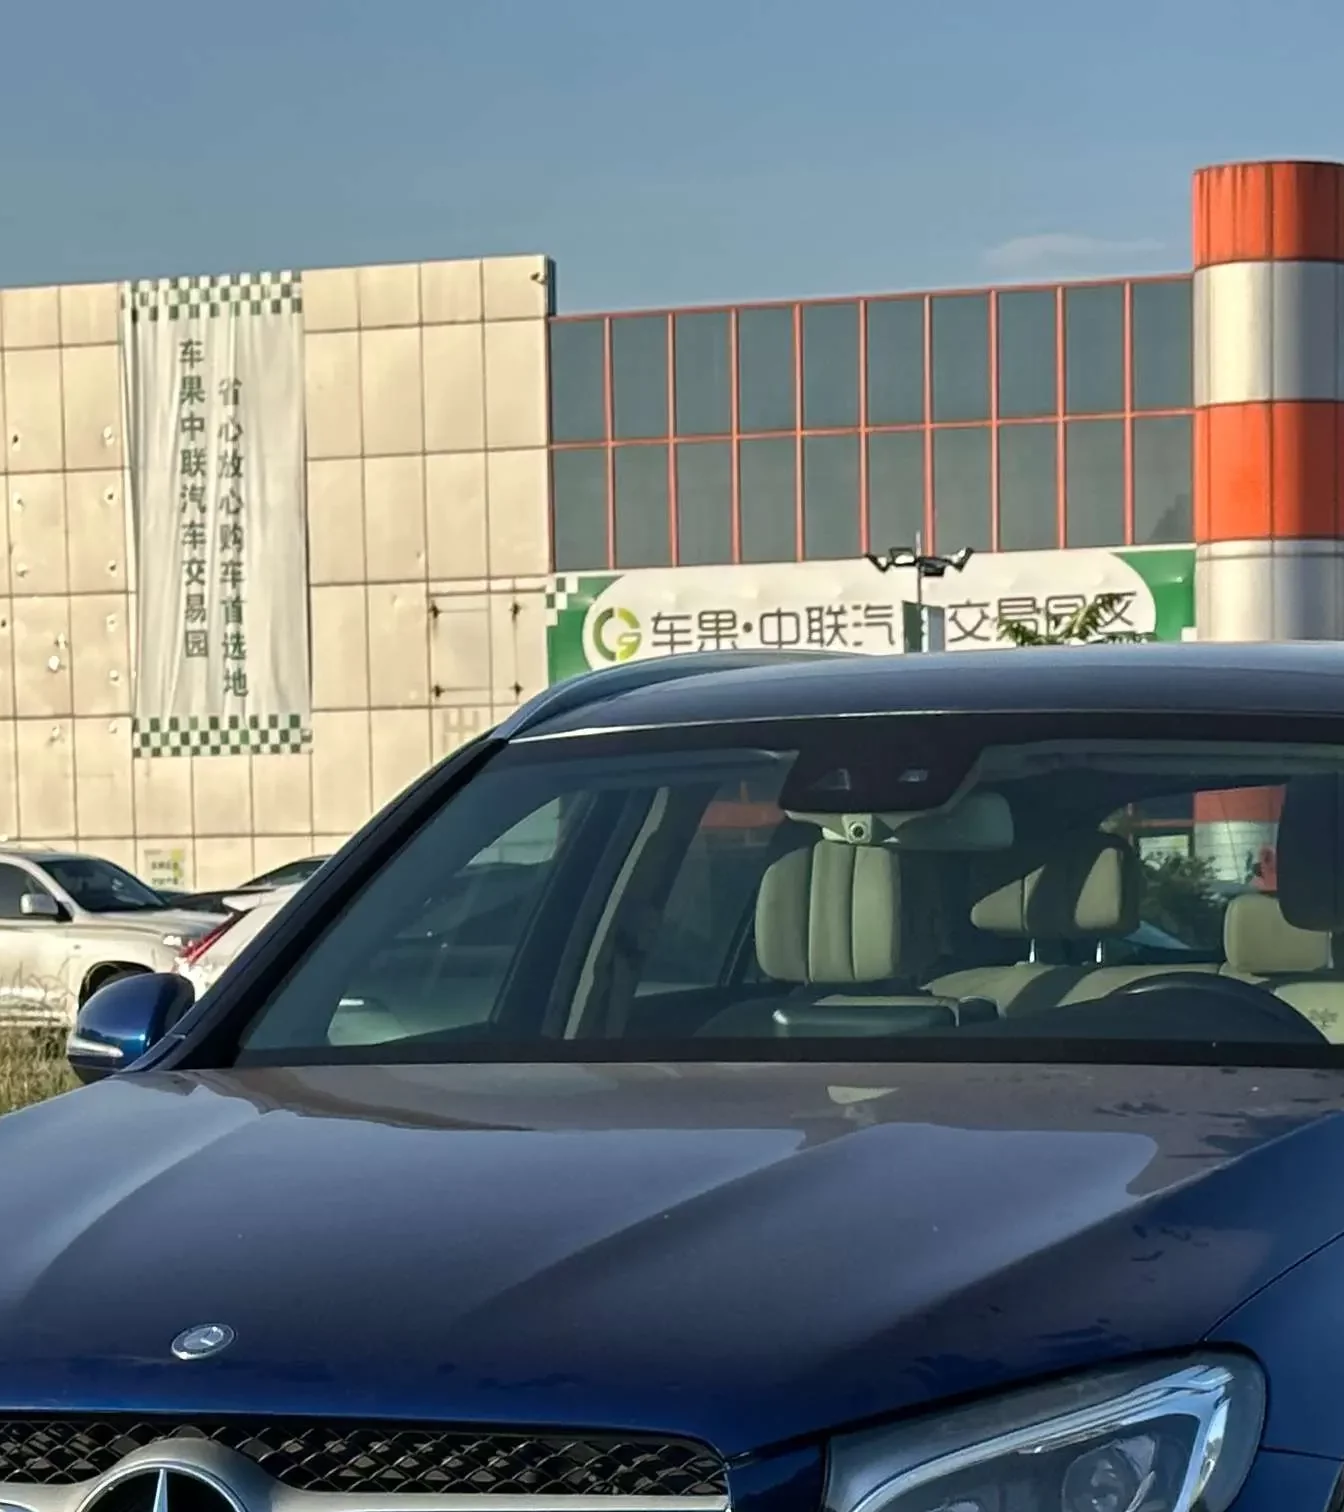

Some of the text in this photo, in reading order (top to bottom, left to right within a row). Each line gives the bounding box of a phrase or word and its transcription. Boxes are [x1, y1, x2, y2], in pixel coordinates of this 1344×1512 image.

[179, 338, 209, 659] 车果中联汽车交易园
[217, 376, 249, 698] 省心放心购车首选地
[651, 590, 1137, 656] 车果·中联汽交易园区
